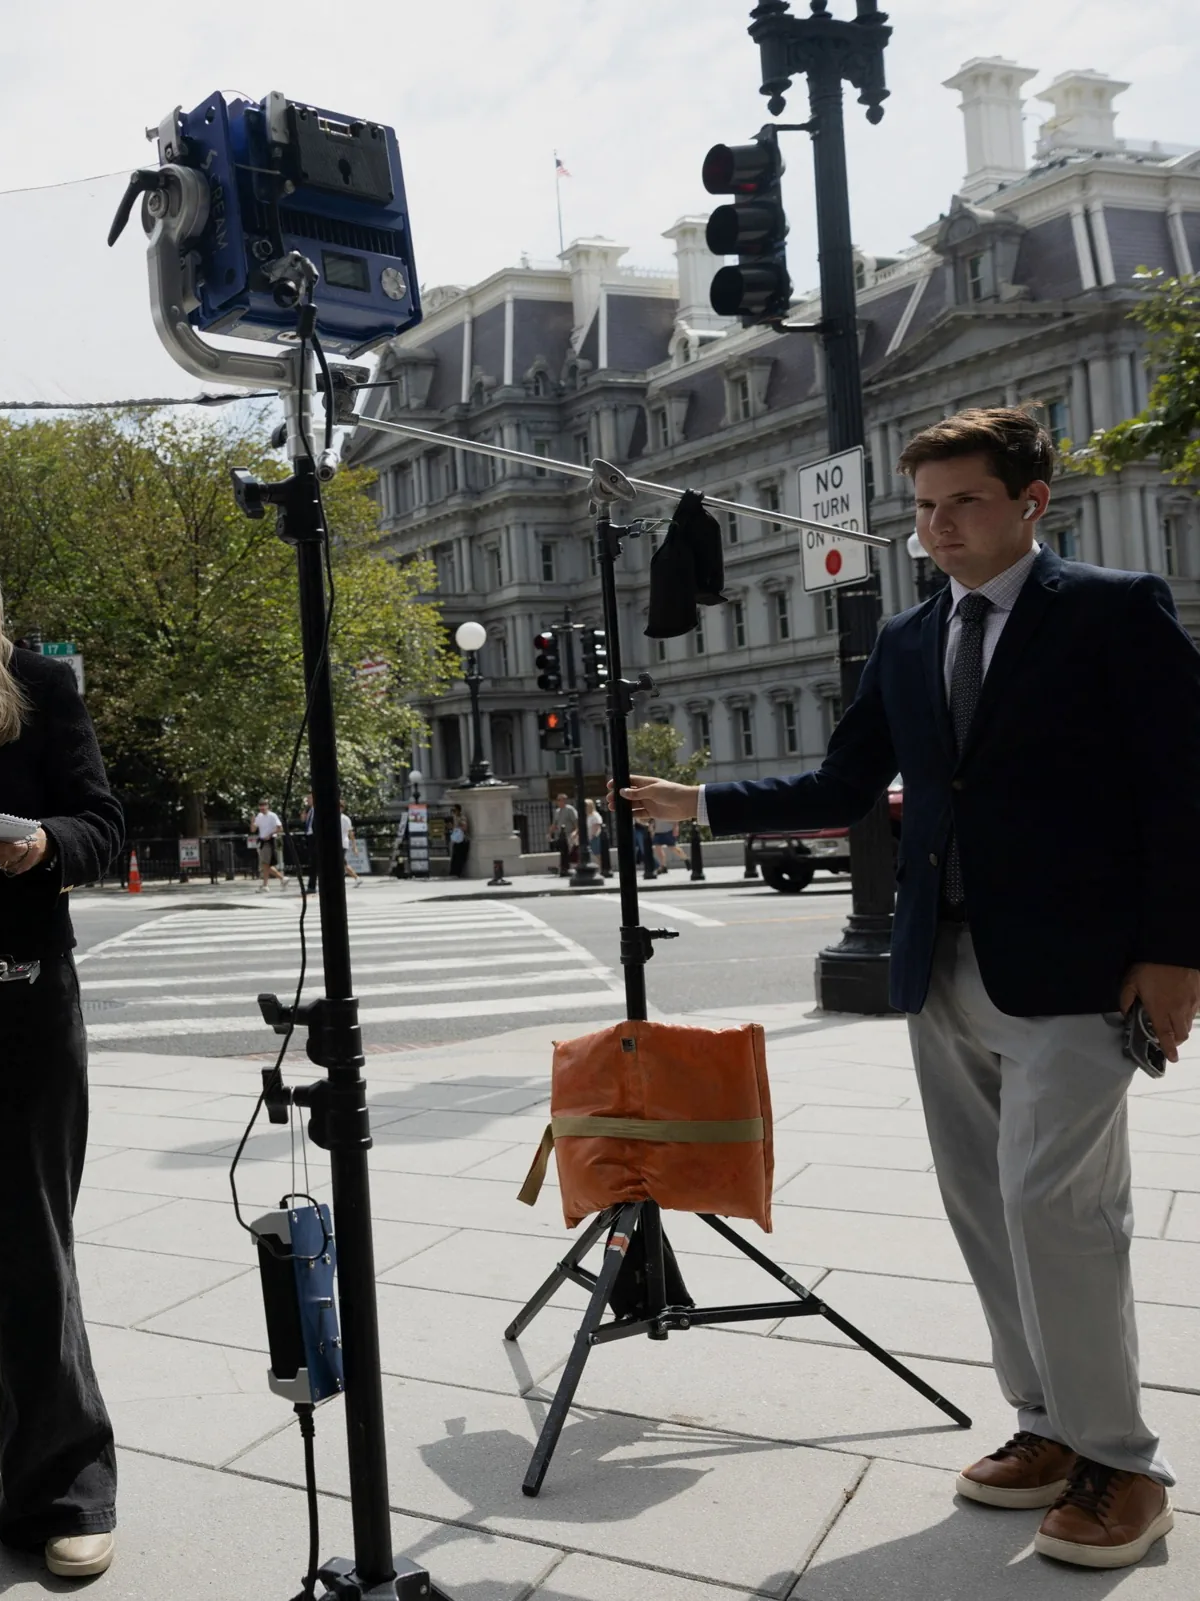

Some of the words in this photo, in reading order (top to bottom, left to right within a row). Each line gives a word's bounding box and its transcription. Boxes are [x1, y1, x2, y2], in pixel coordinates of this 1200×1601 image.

[815, 465, 843, 495] NO
[812, 493, 850, 521] TURN
[806, 531, 825, 549] ON
[47, 644, 60, 655] 17
